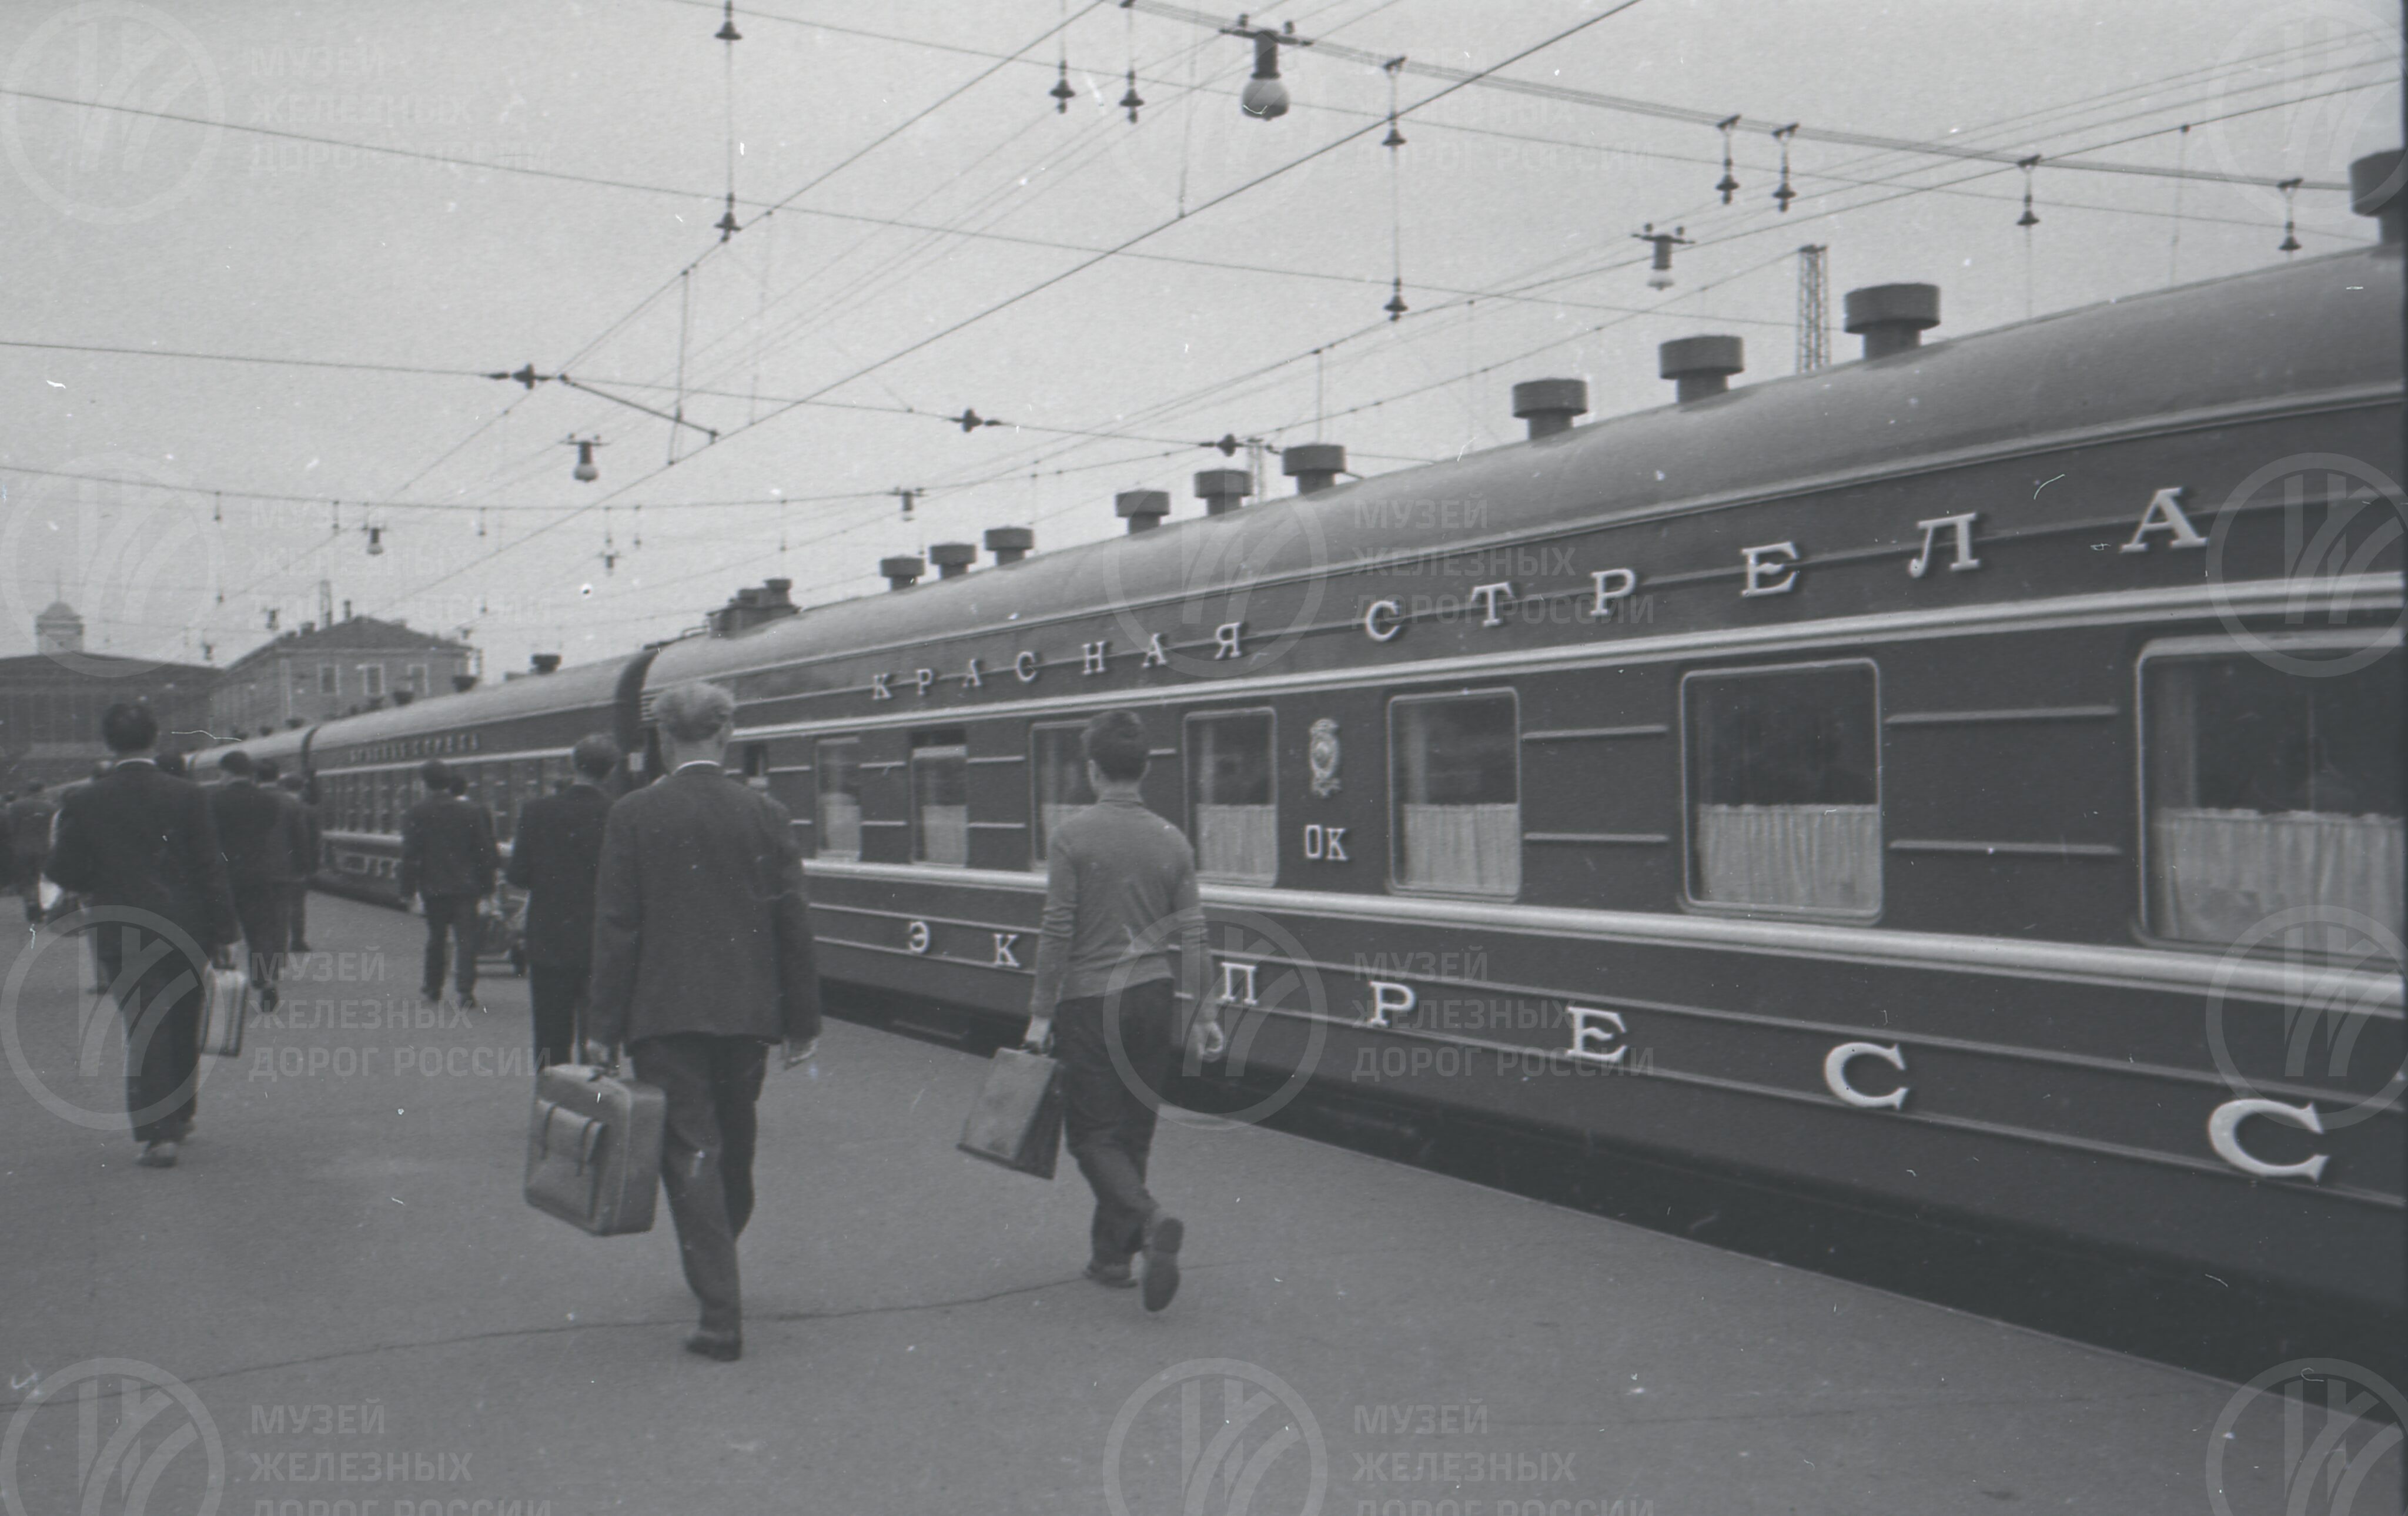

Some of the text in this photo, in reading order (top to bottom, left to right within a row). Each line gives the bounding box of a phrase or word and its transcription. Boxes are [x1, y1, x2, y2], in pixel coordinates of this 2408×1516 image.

[871, 487, 2208, 701] КРАСНАЯ СТРЕЛА
[1305, 824, 1349, 861] ОК
[907, 921, 2331, 1181] ЭКПРЕСС
